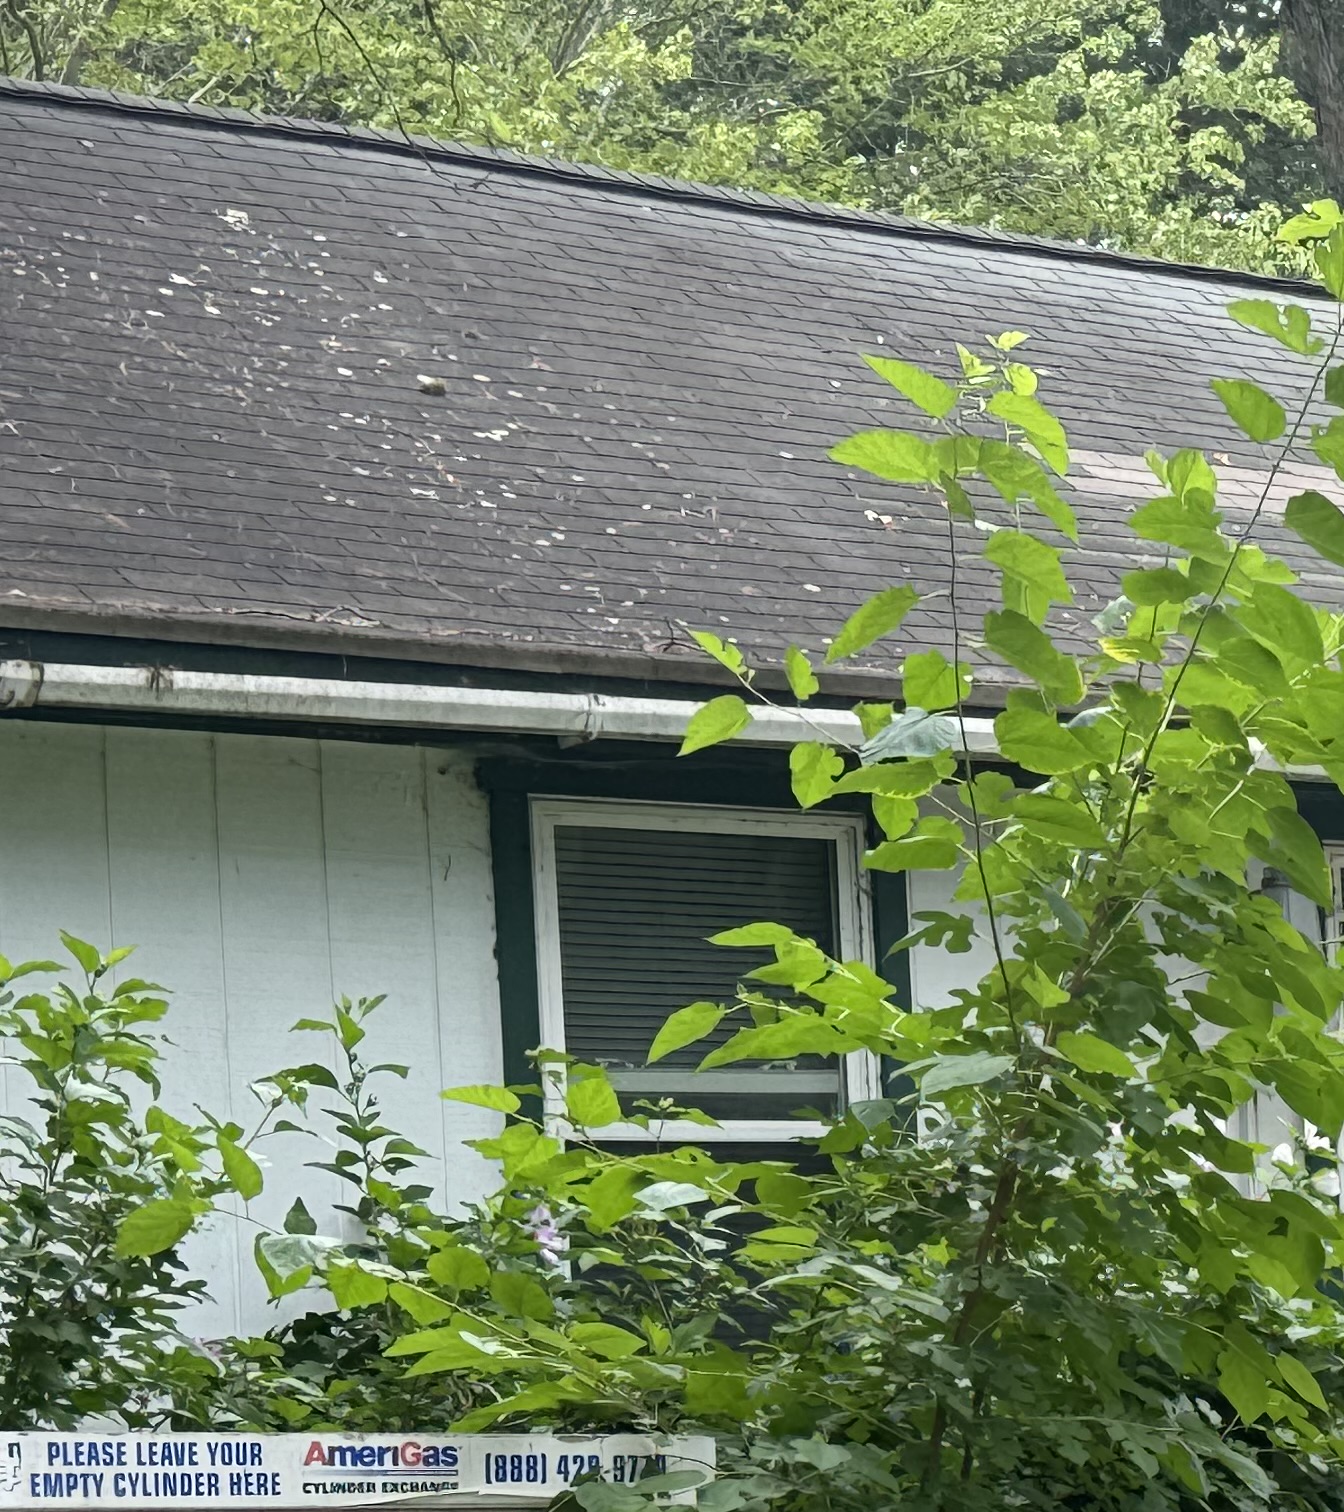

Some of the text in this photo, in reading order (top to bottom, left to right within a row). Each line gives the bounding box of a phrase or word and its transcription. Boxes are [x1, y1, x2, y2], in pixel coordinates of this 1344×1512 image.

[48, 1441, 263, 1467] PLEASE LEAVE YOUR
[303, 1440, 459, 1467] AmeriGas
[485, 1453, 547, 1484] (888)
[30, 1472, 282, 1498] EMPTY CYLINDER HERE
